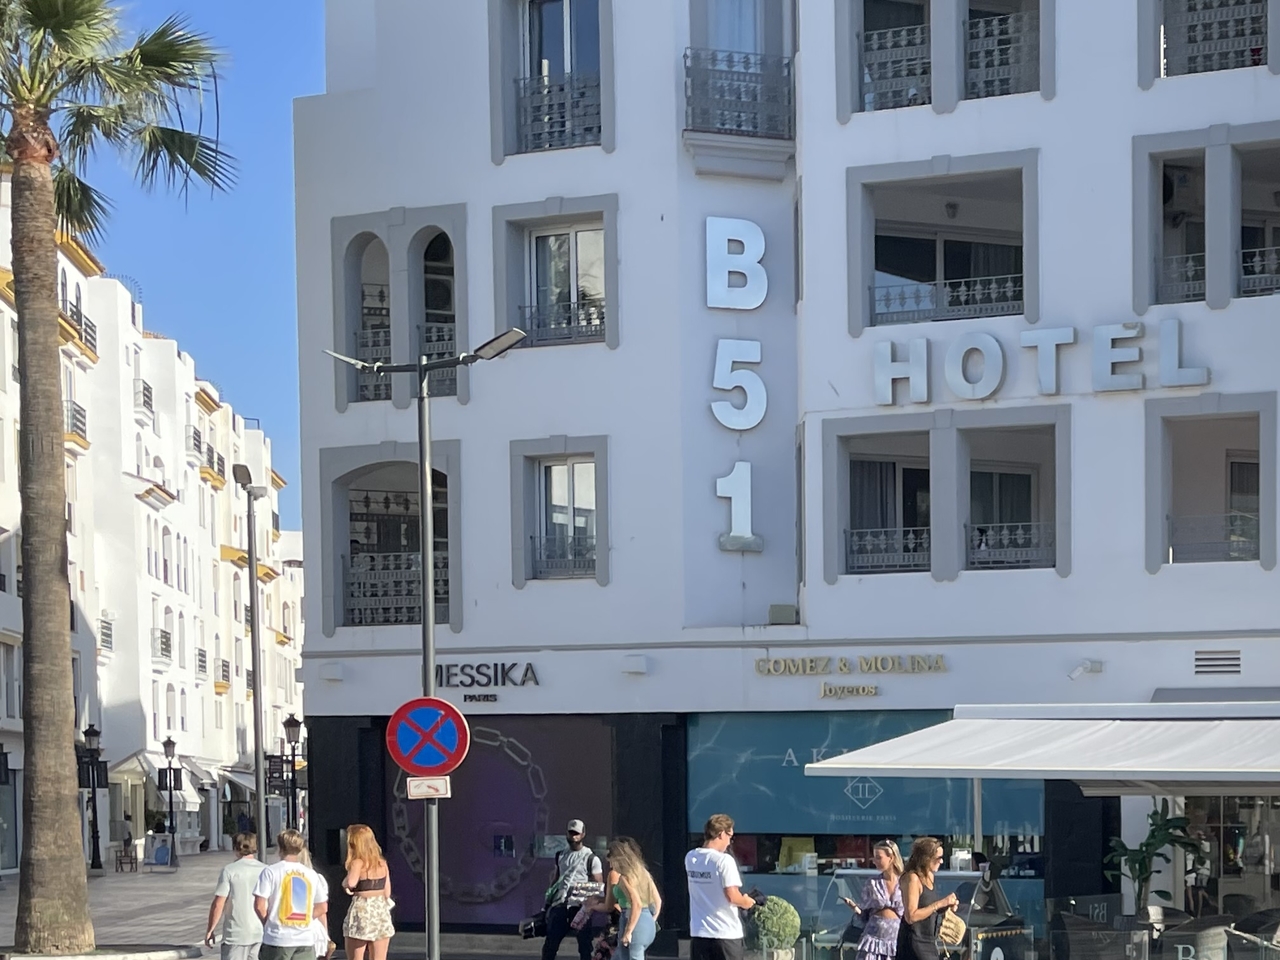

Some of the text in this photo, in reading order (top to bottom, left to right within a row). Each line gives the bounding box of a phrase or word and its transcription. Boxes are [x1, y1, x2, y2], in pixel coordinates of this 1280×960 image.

[874, 318, 1211, 406] HOTEL
[705, 216, 769, 552] B51
[755, 653, 948, 676] GOMEZ & MOLINA
[463, 693, 498, 703] PARIS
[819, 681, 878, 700] Joyeros
[782, 747, 849, 767] AK
